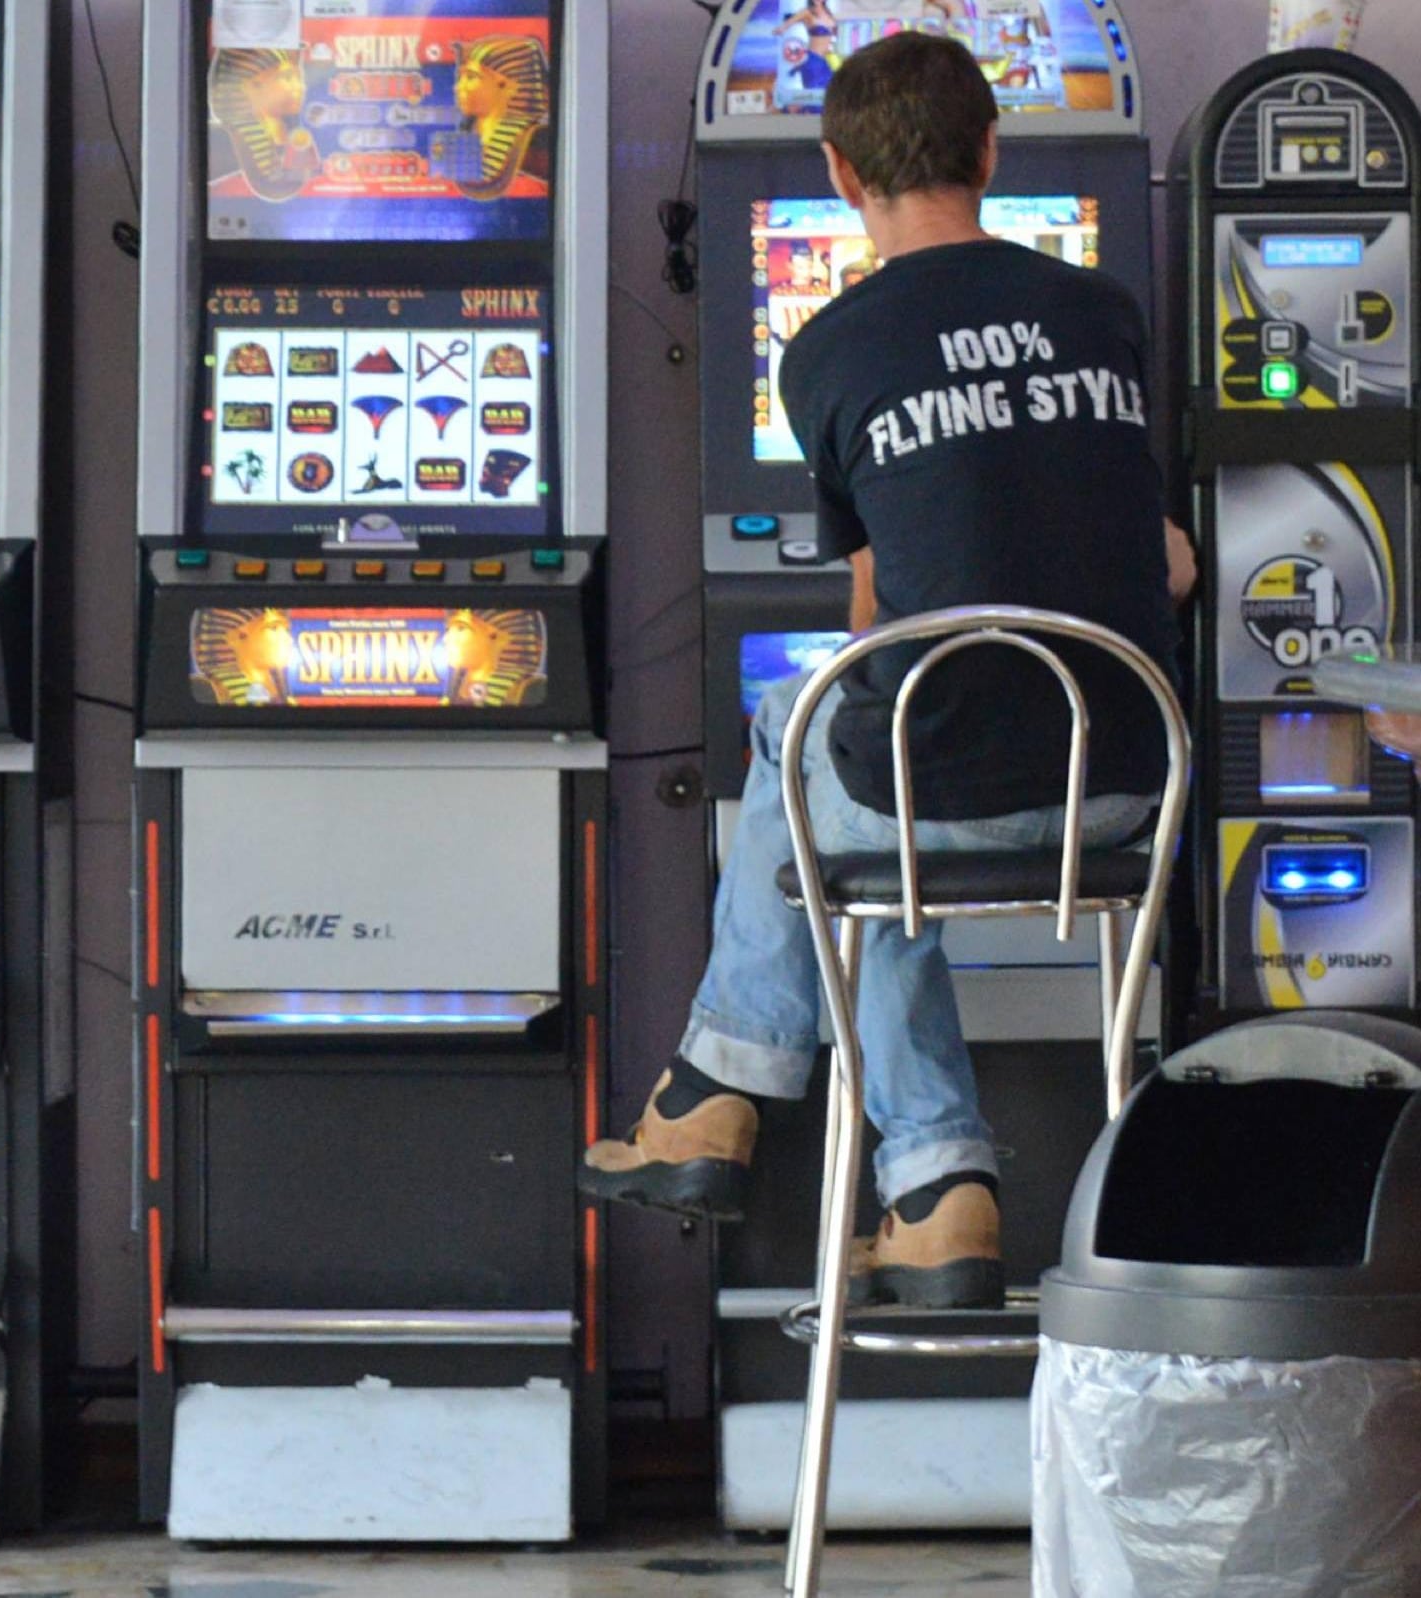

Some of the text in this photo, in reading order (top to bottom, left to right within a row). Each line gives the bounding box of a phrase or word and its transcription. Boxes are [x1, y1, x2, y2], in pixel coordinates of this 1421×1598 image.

[334, 36, 421, 68] SPHINX
[461, 289, 539, 318] SPHINX
[938, 320, 1054, 372] 100%
[866, 379, 1014, 466] FLYING
[298, 632, 441, 684] SPHINX
[235, 914, 343, 939] ACME
